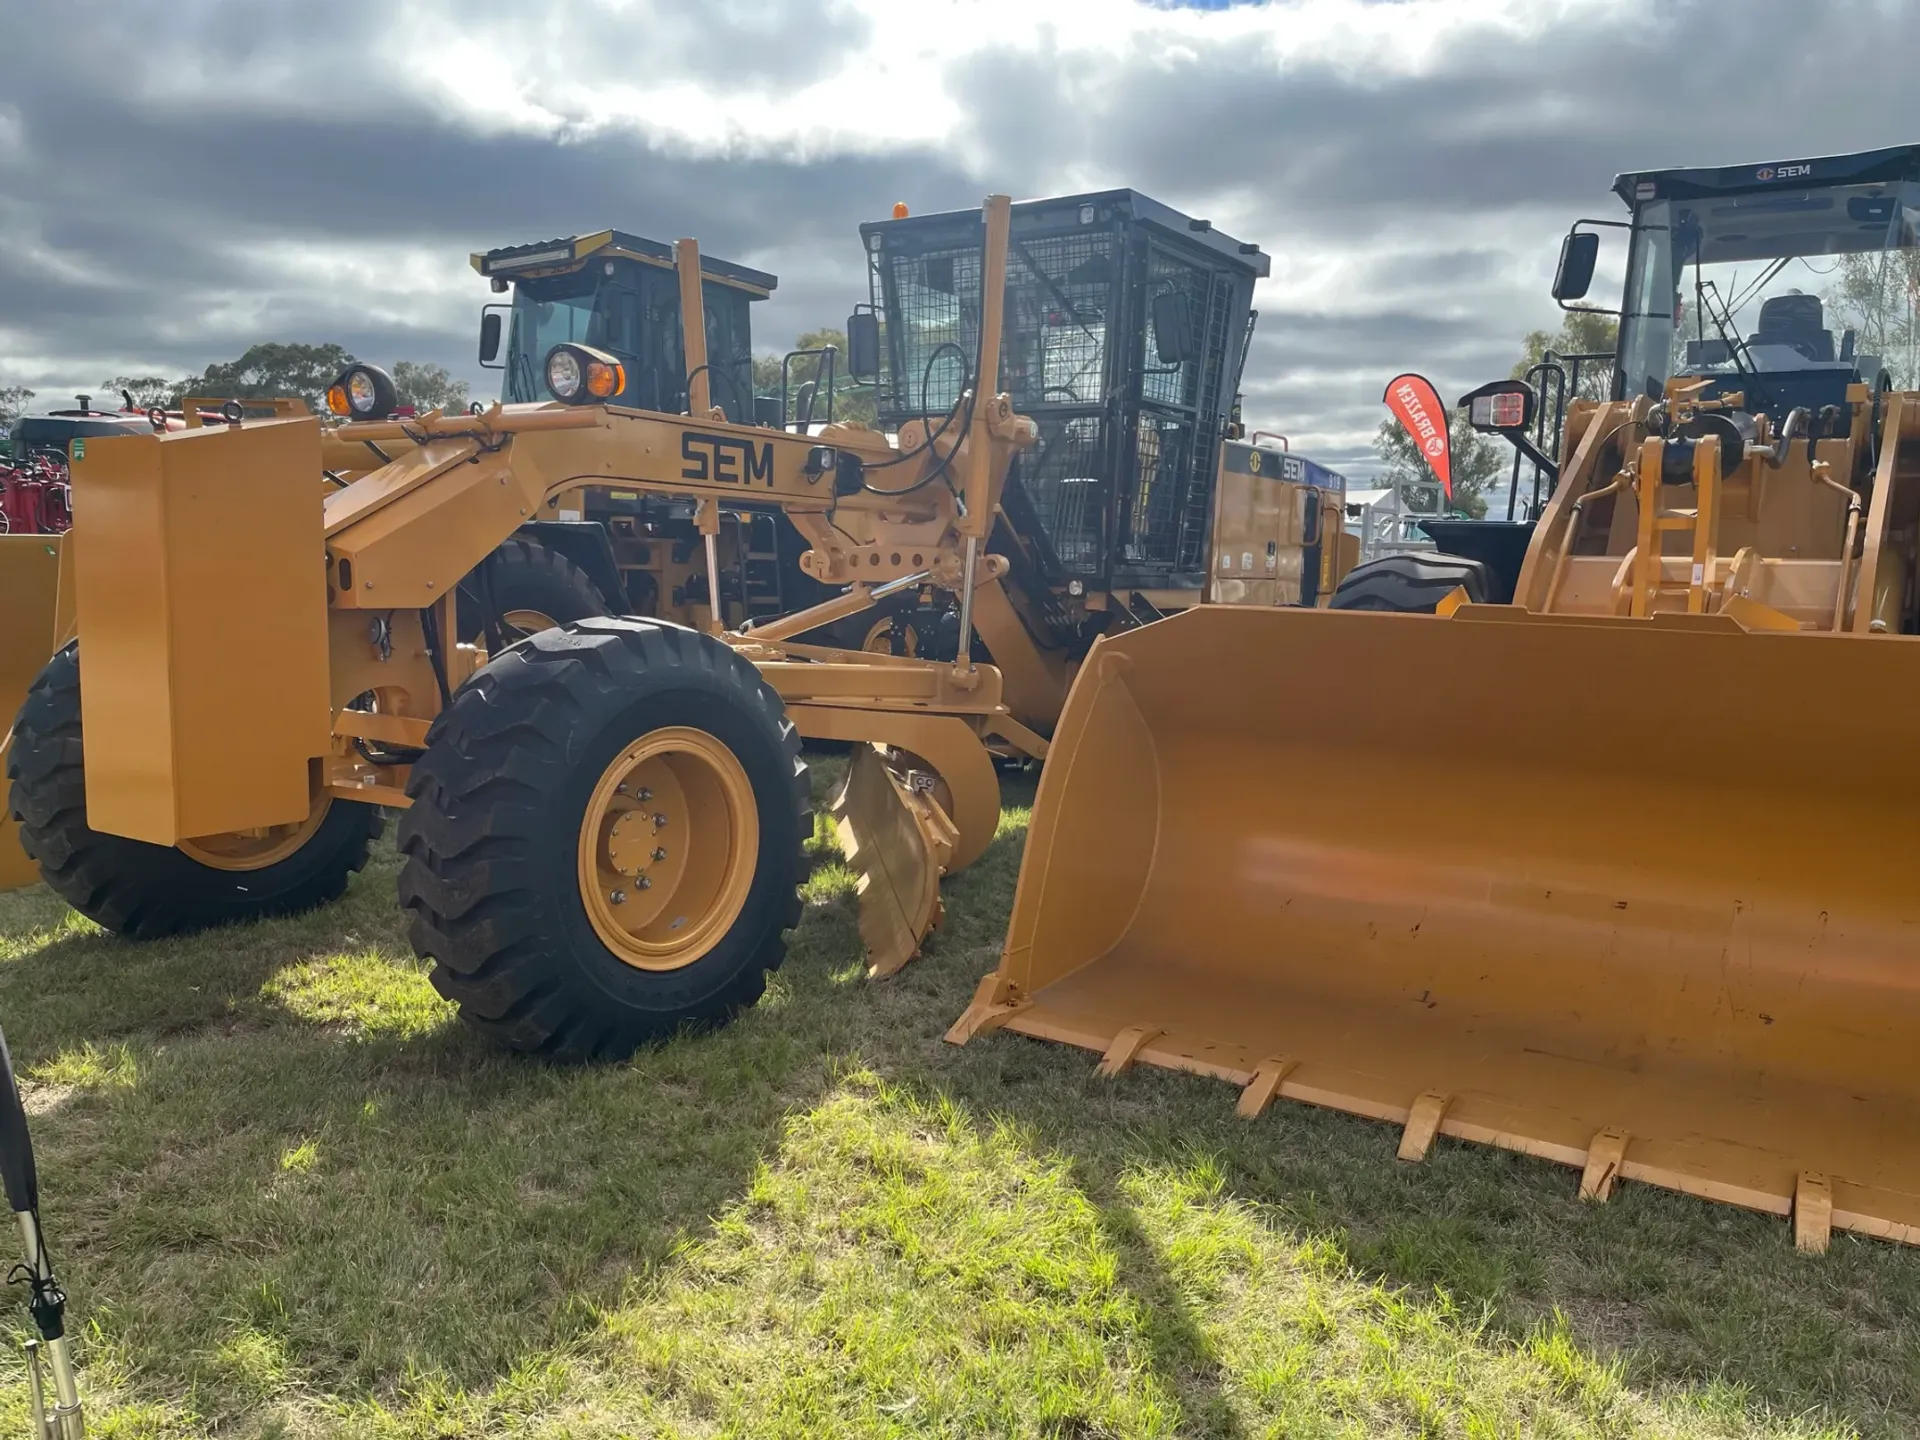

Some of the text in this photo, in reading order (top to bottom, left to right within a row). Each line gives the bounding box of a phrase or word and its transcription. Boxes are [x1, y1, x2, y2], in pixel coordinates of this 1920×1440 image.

[1777, 164, 1811, 178] SEM
[682, 431, 773, 487] SEM
[1283, 457, 1305, 482] SEM
